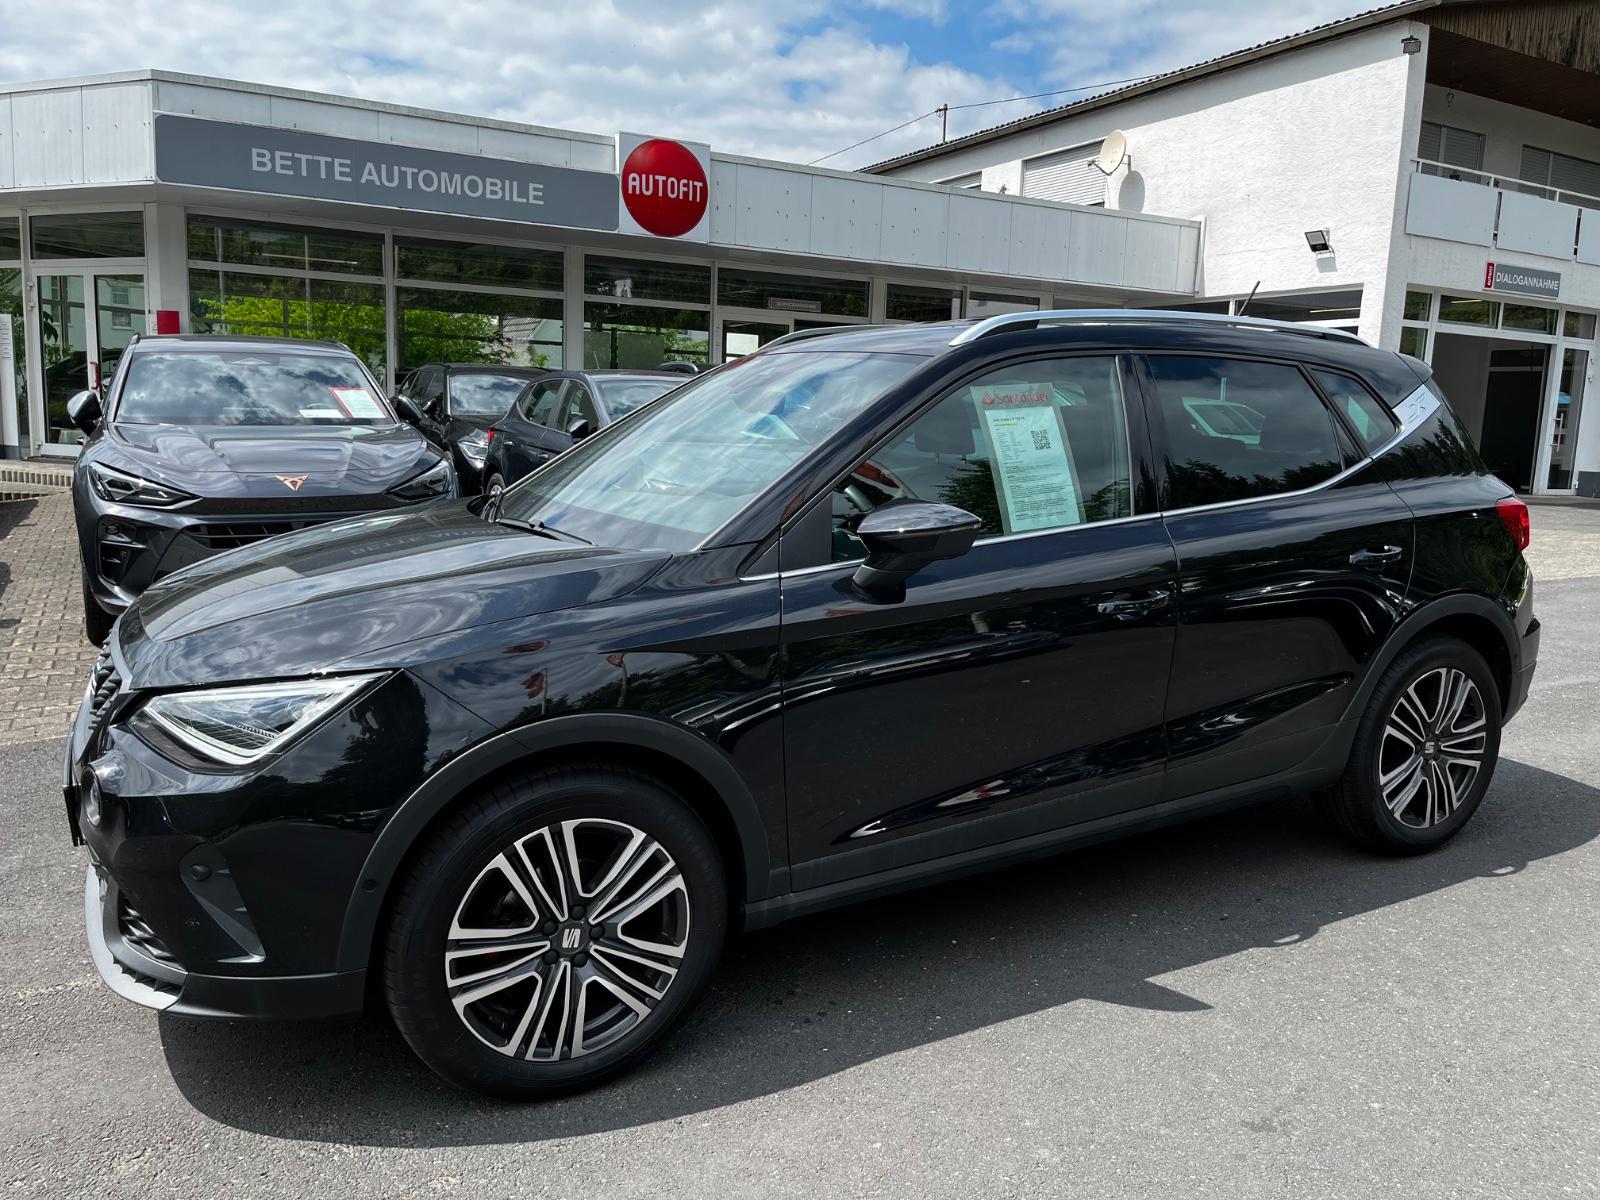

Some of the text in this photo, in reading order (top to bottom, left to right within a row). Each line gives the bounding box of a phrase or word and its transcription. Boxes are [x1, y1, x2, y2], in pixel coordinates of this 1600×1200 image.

[251, 148, 545, 205] BETTE AUTOMOBILE
[627, 172, 704, 203] AUTOFIT
[1496, 272, 1558, 290] DIALOGANNAHME
